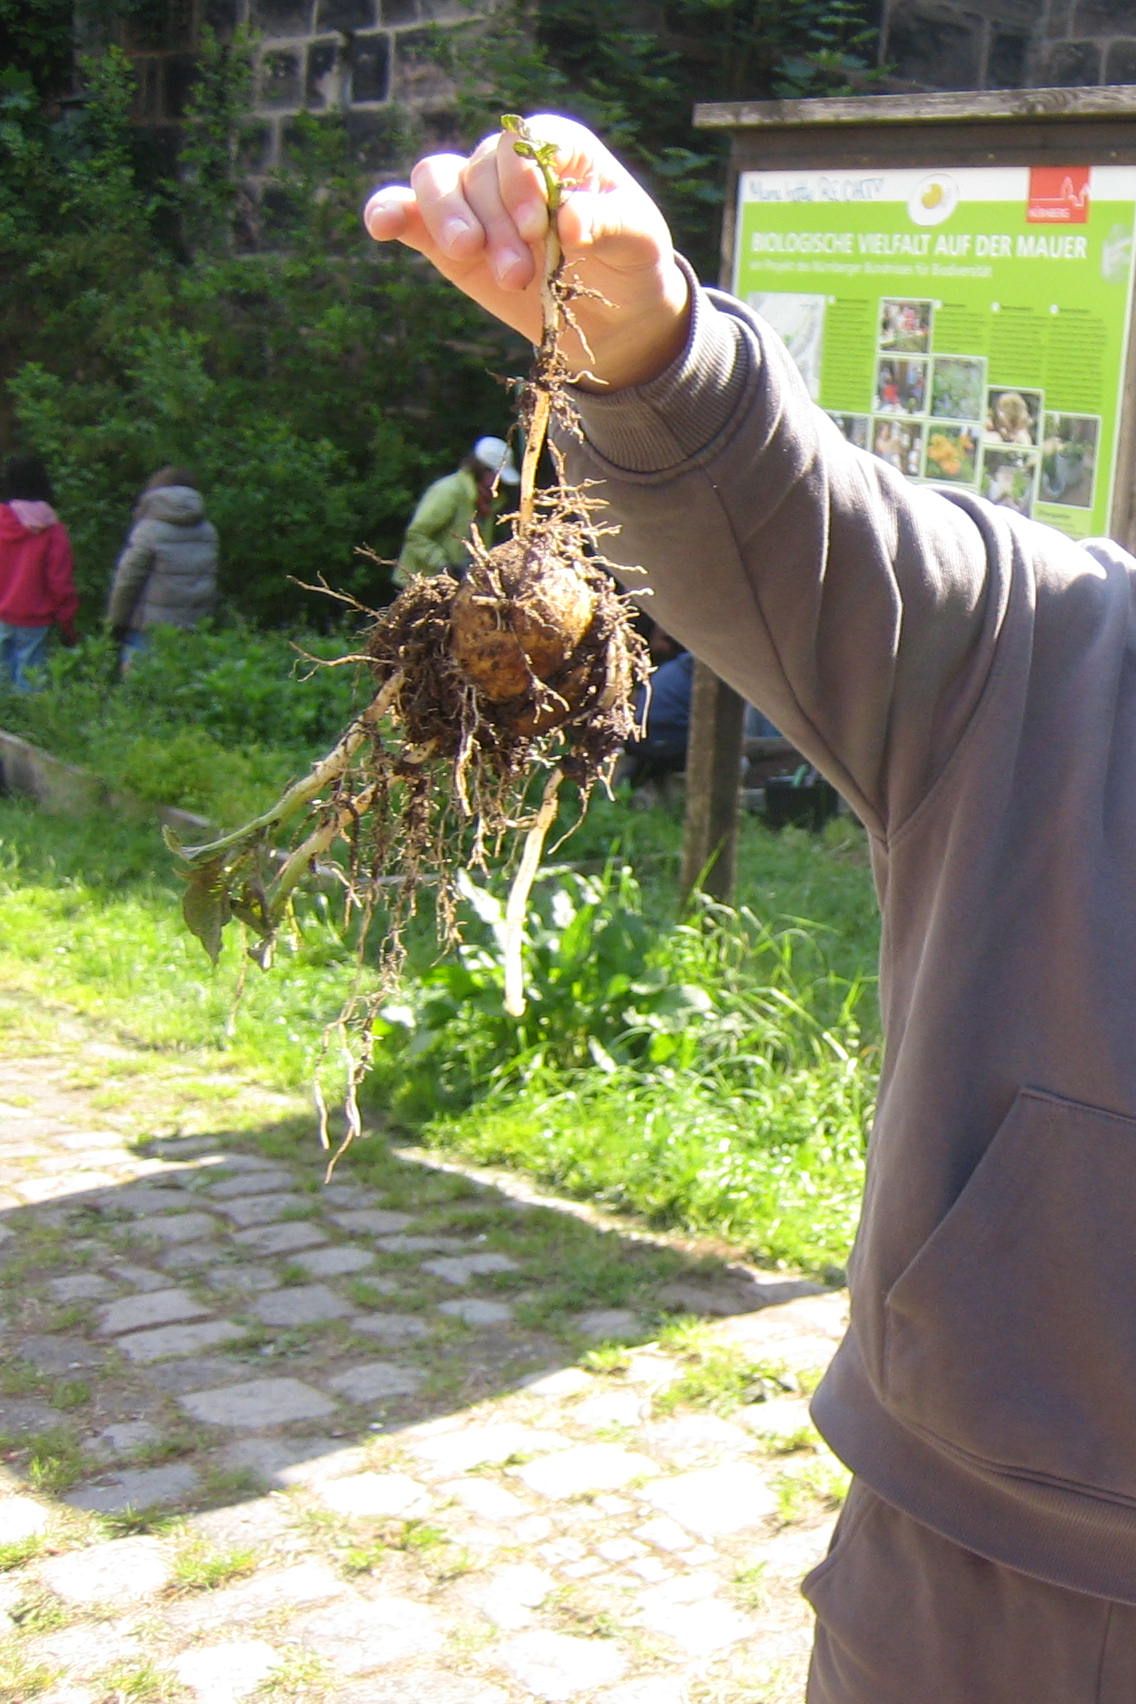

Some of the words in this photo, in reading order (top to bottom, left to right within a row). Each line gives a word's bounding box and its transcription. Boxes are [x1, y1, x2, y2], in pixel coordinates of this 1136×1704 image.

[751, 231, 853, 254] BIOLOGISCHE
[857, 232, 931, 256] VIELFALT
[934, 233, 971, 256] AUF
[975, 234, 1012, 257] DER
[1016, 235, 1088, 259] MAUER
